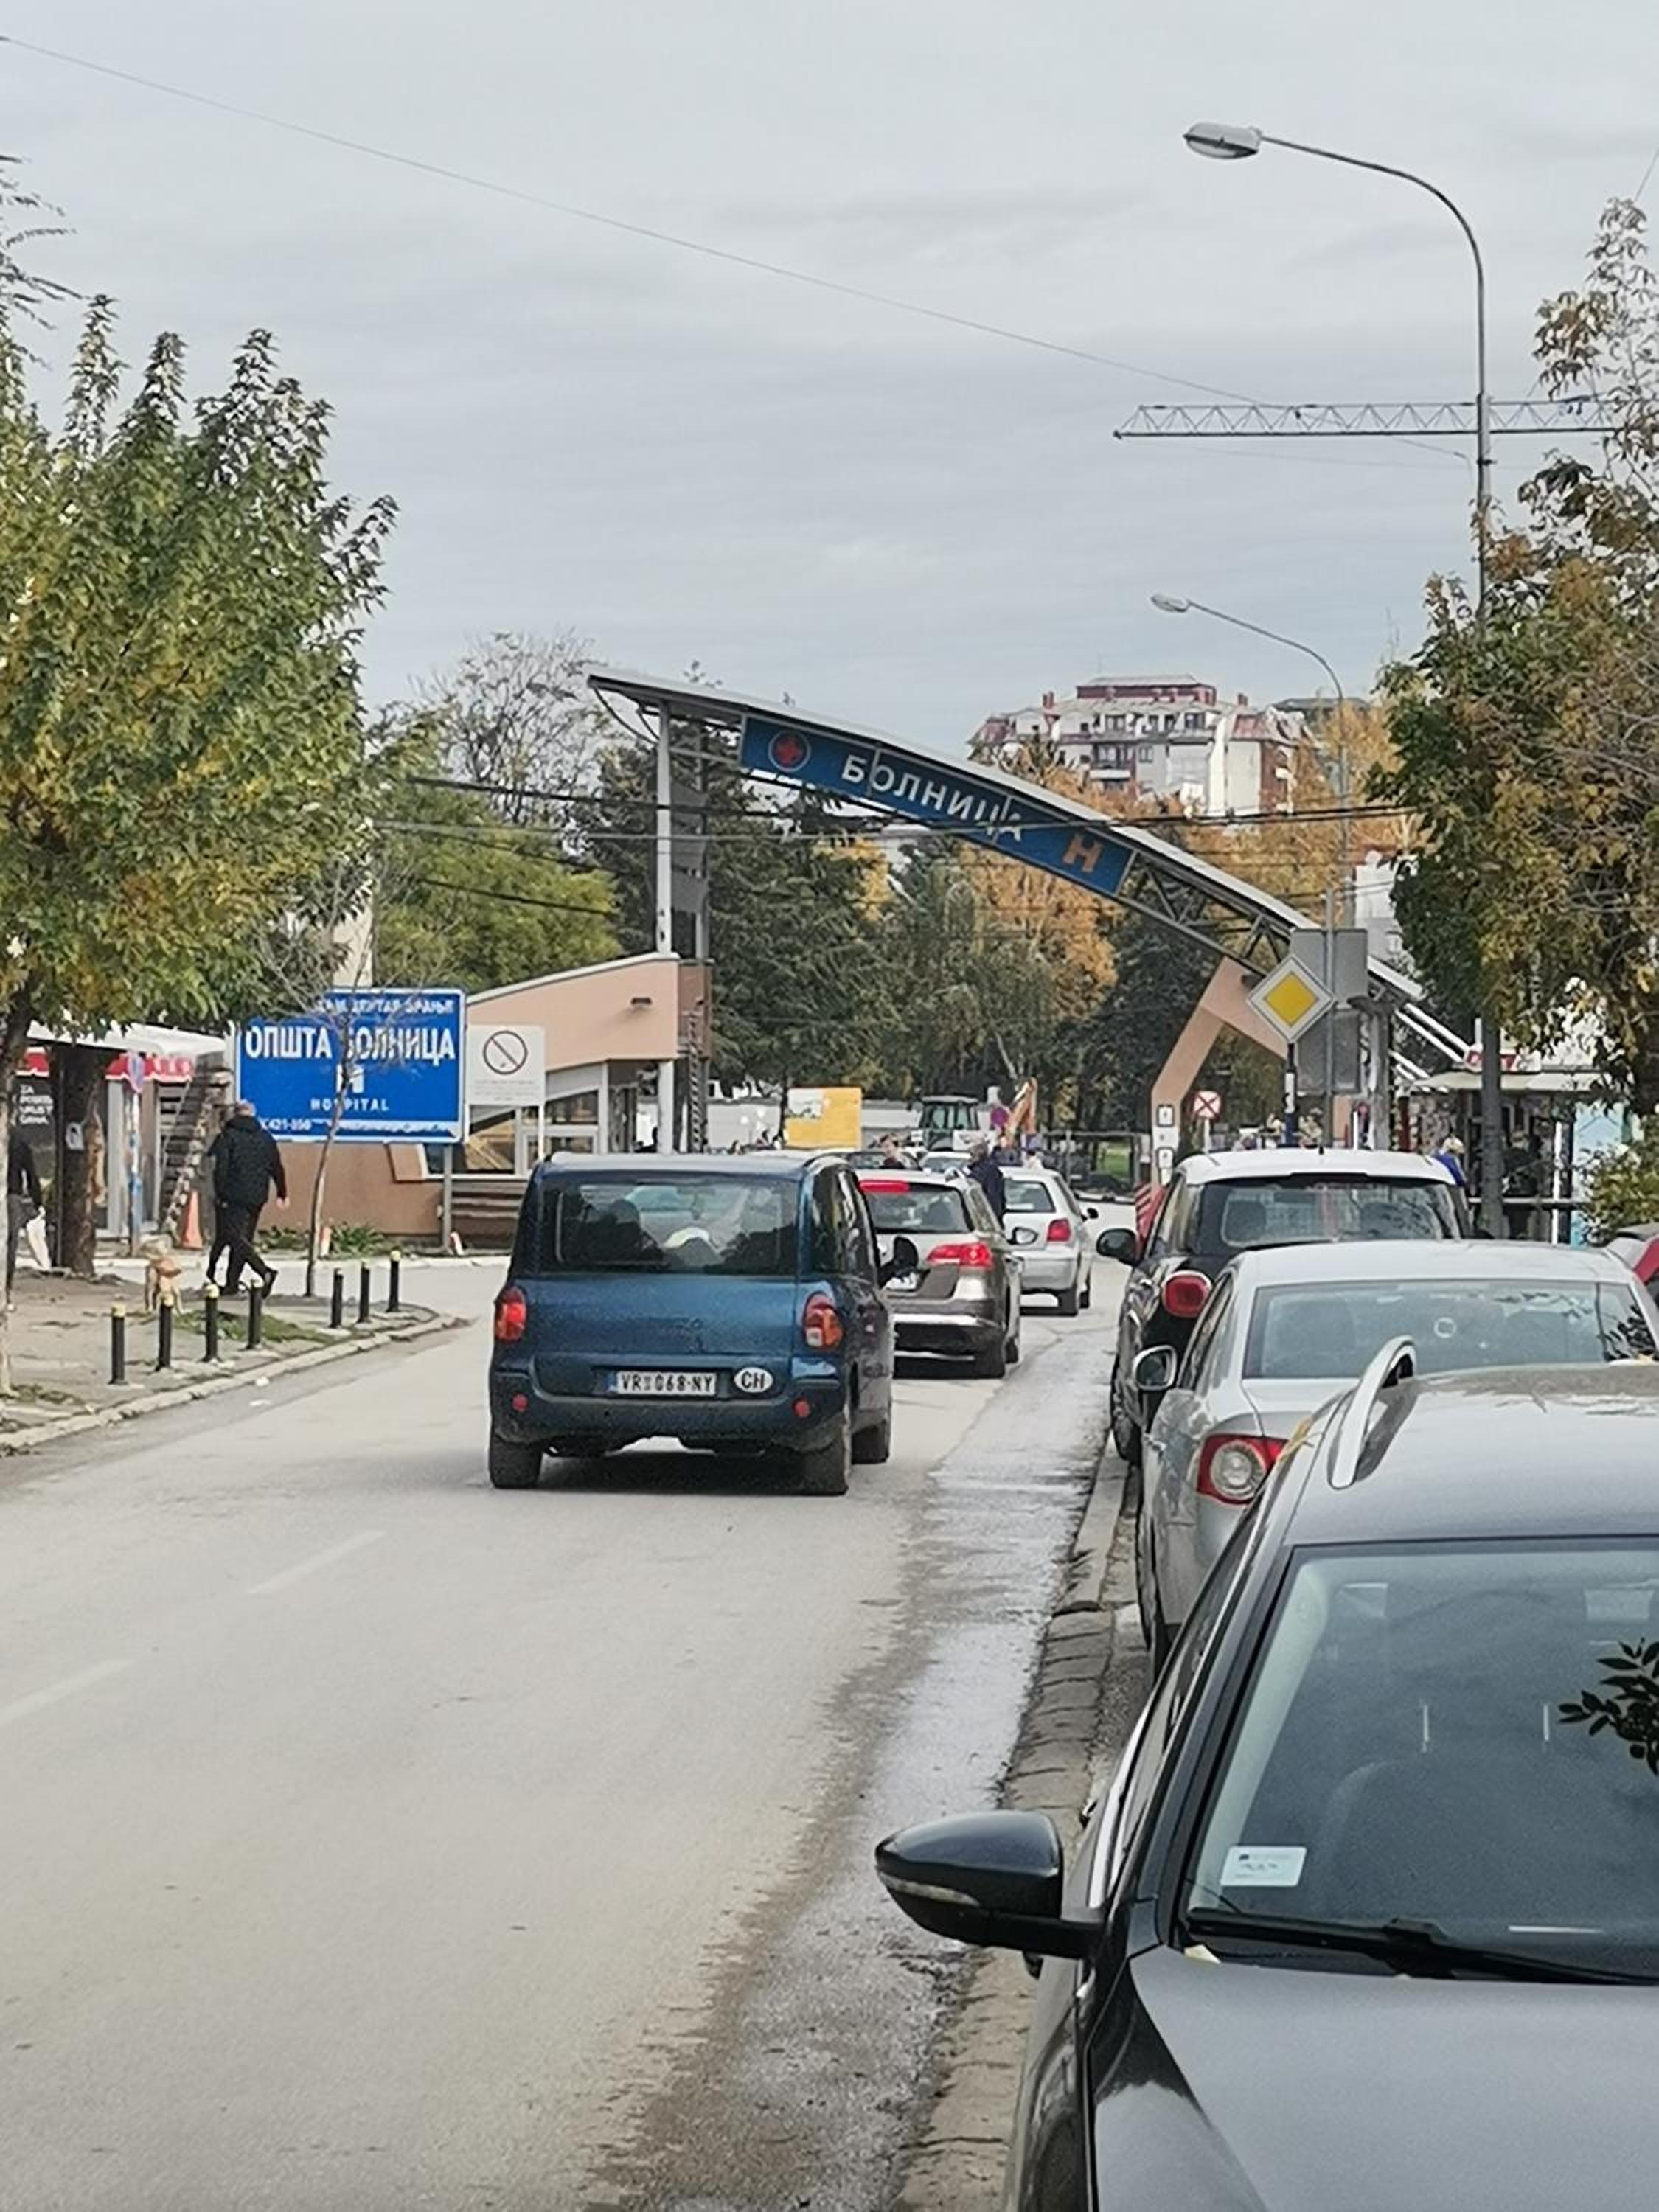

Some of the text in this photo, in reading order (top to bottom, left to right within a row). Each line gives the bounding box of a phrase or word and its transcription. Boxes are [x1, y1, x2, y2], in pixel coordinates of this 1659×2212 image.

[841, 754, 1023, 841] БОЛНИЦА
[245, 1026, 333, 1060] ОПШТА
[310, 1099, 389, 1111] HOPITAL
[622, 1374, 641, 1391] VR
[741, 1371, 765, 1389] CH
